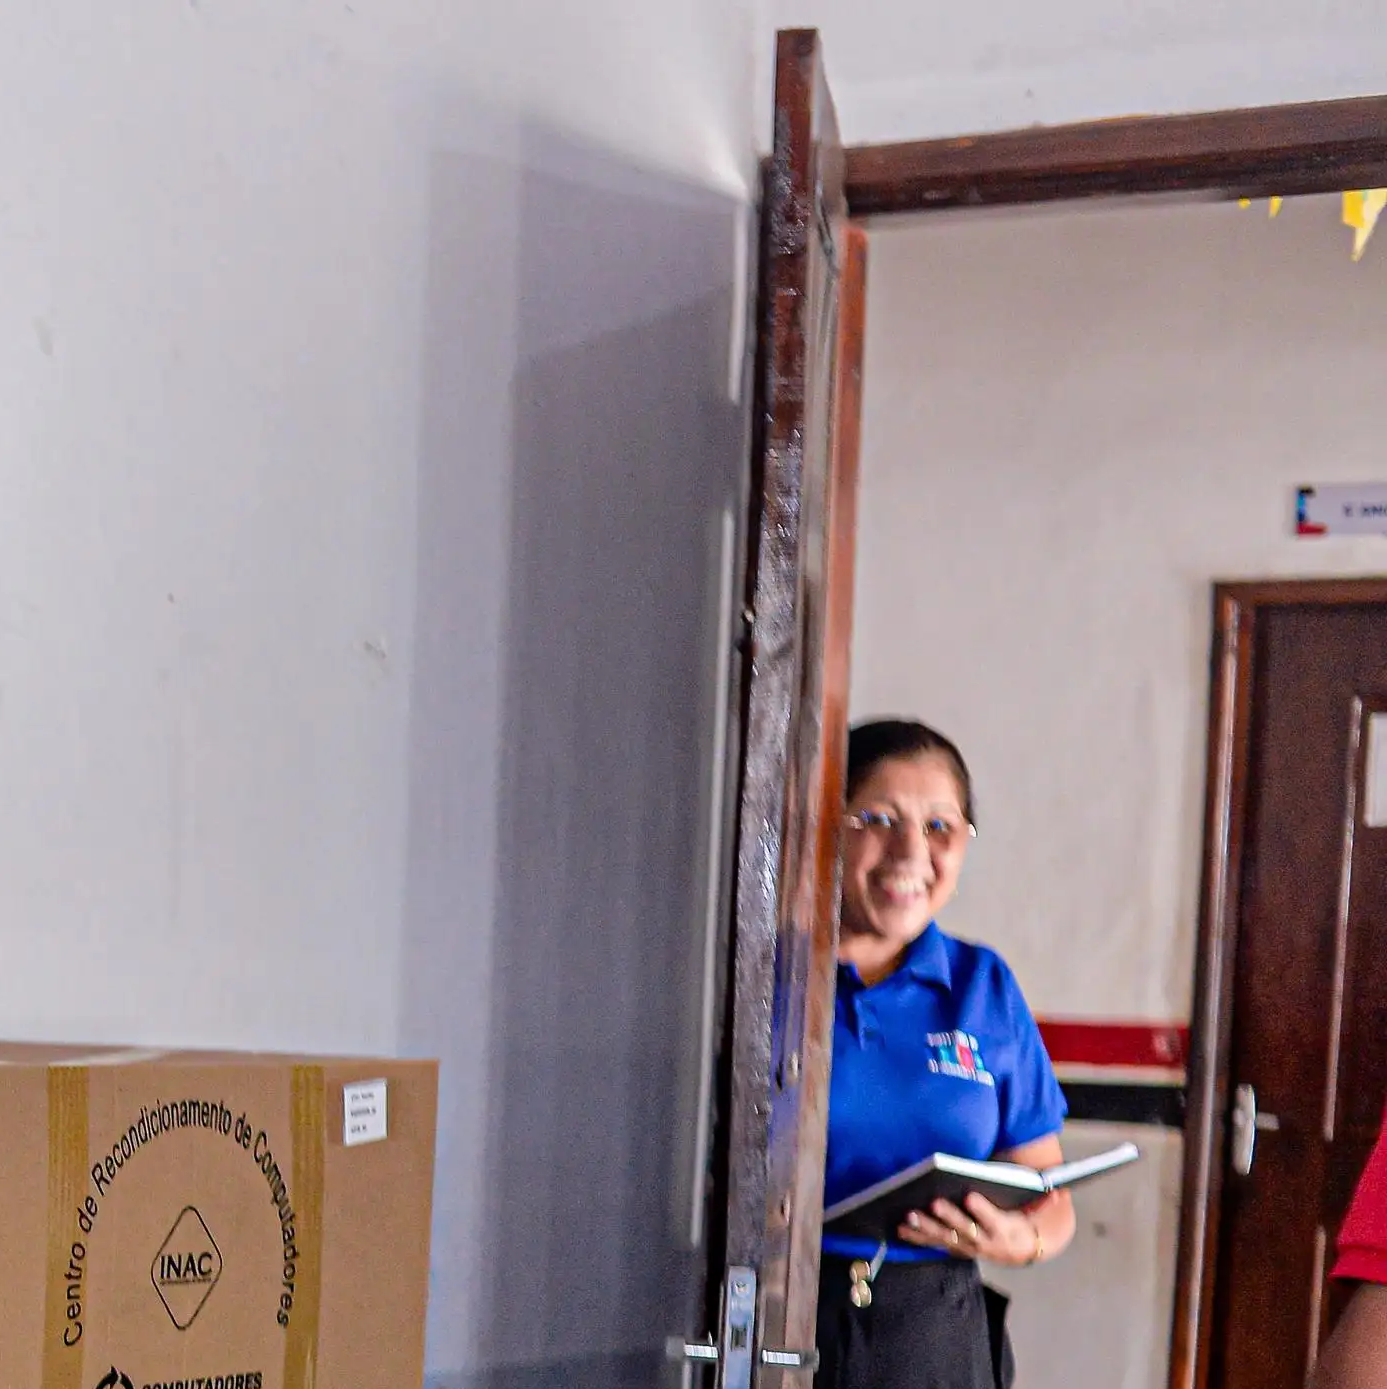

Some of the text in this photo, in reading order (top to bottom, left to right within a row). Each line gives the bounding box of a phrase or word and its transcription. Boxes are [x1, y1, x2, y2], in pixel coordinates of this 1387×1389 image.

[63, 1097, 300, 1347] Centro de Recondicionamento de Computadores
[160, 1252, 212, 1279] INAC
